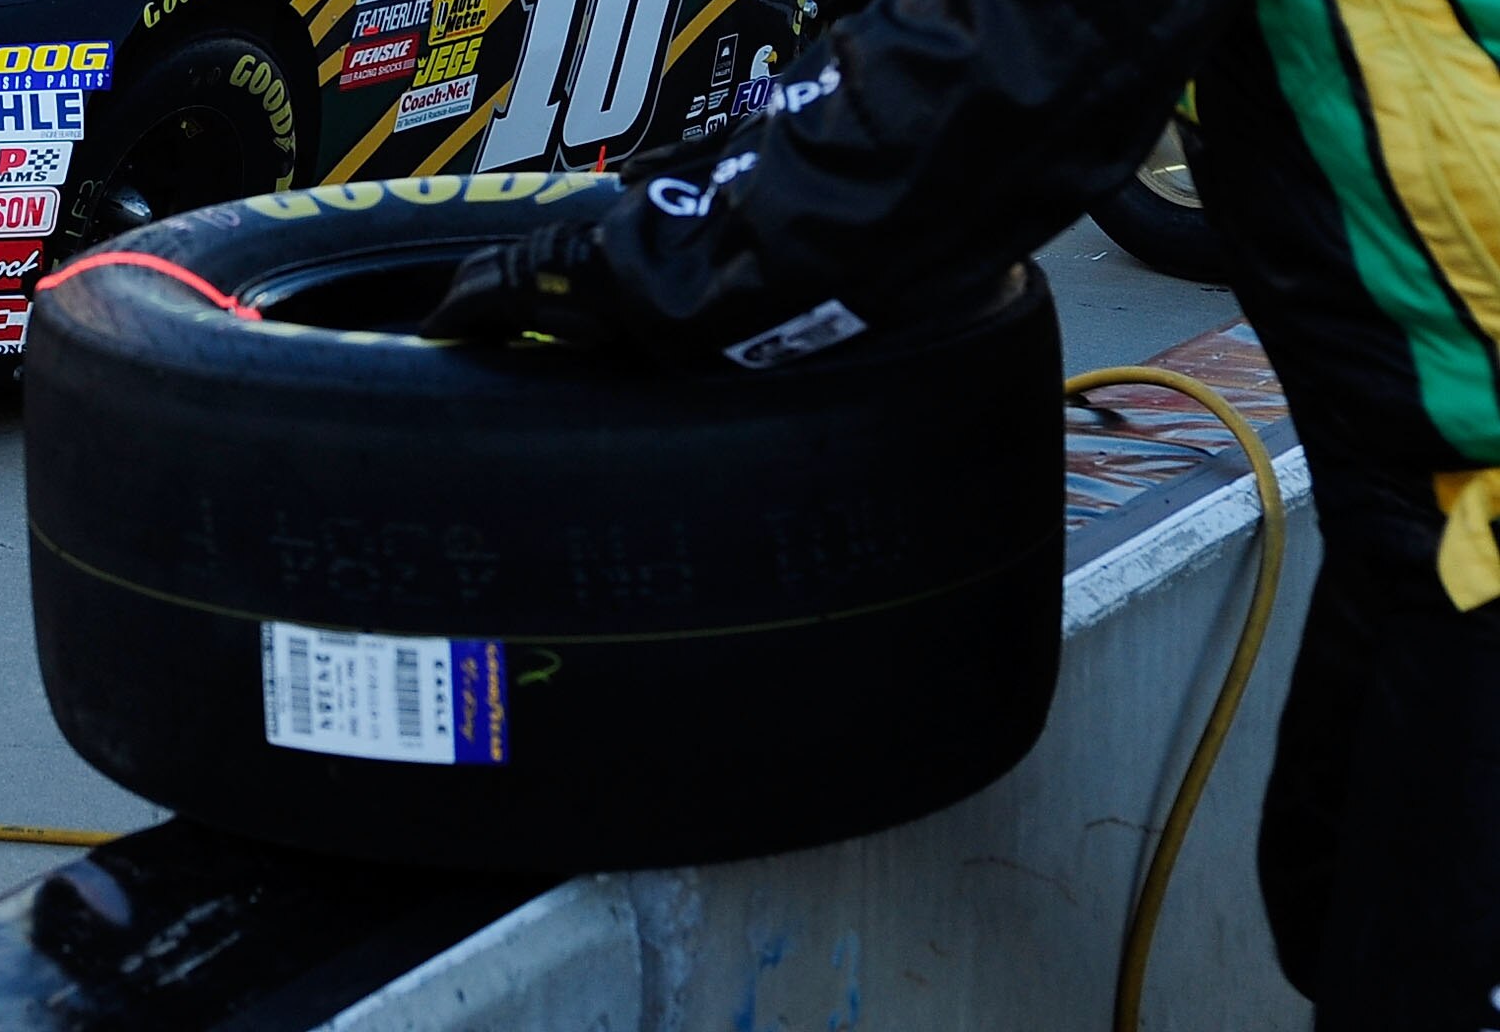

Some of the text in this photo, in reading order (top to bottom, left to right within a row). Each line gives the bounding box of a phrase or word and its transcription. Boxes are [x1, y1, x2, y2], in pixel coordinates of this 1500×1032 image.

[445, 8, 487, 35] Meter
[349, 39, 413, 69] PENSKE
[411, 36, 484, 88] JEGS
[46, 73, 104, 89] PARTS
[352, 62, 404, 81] RACING SHOCKS
